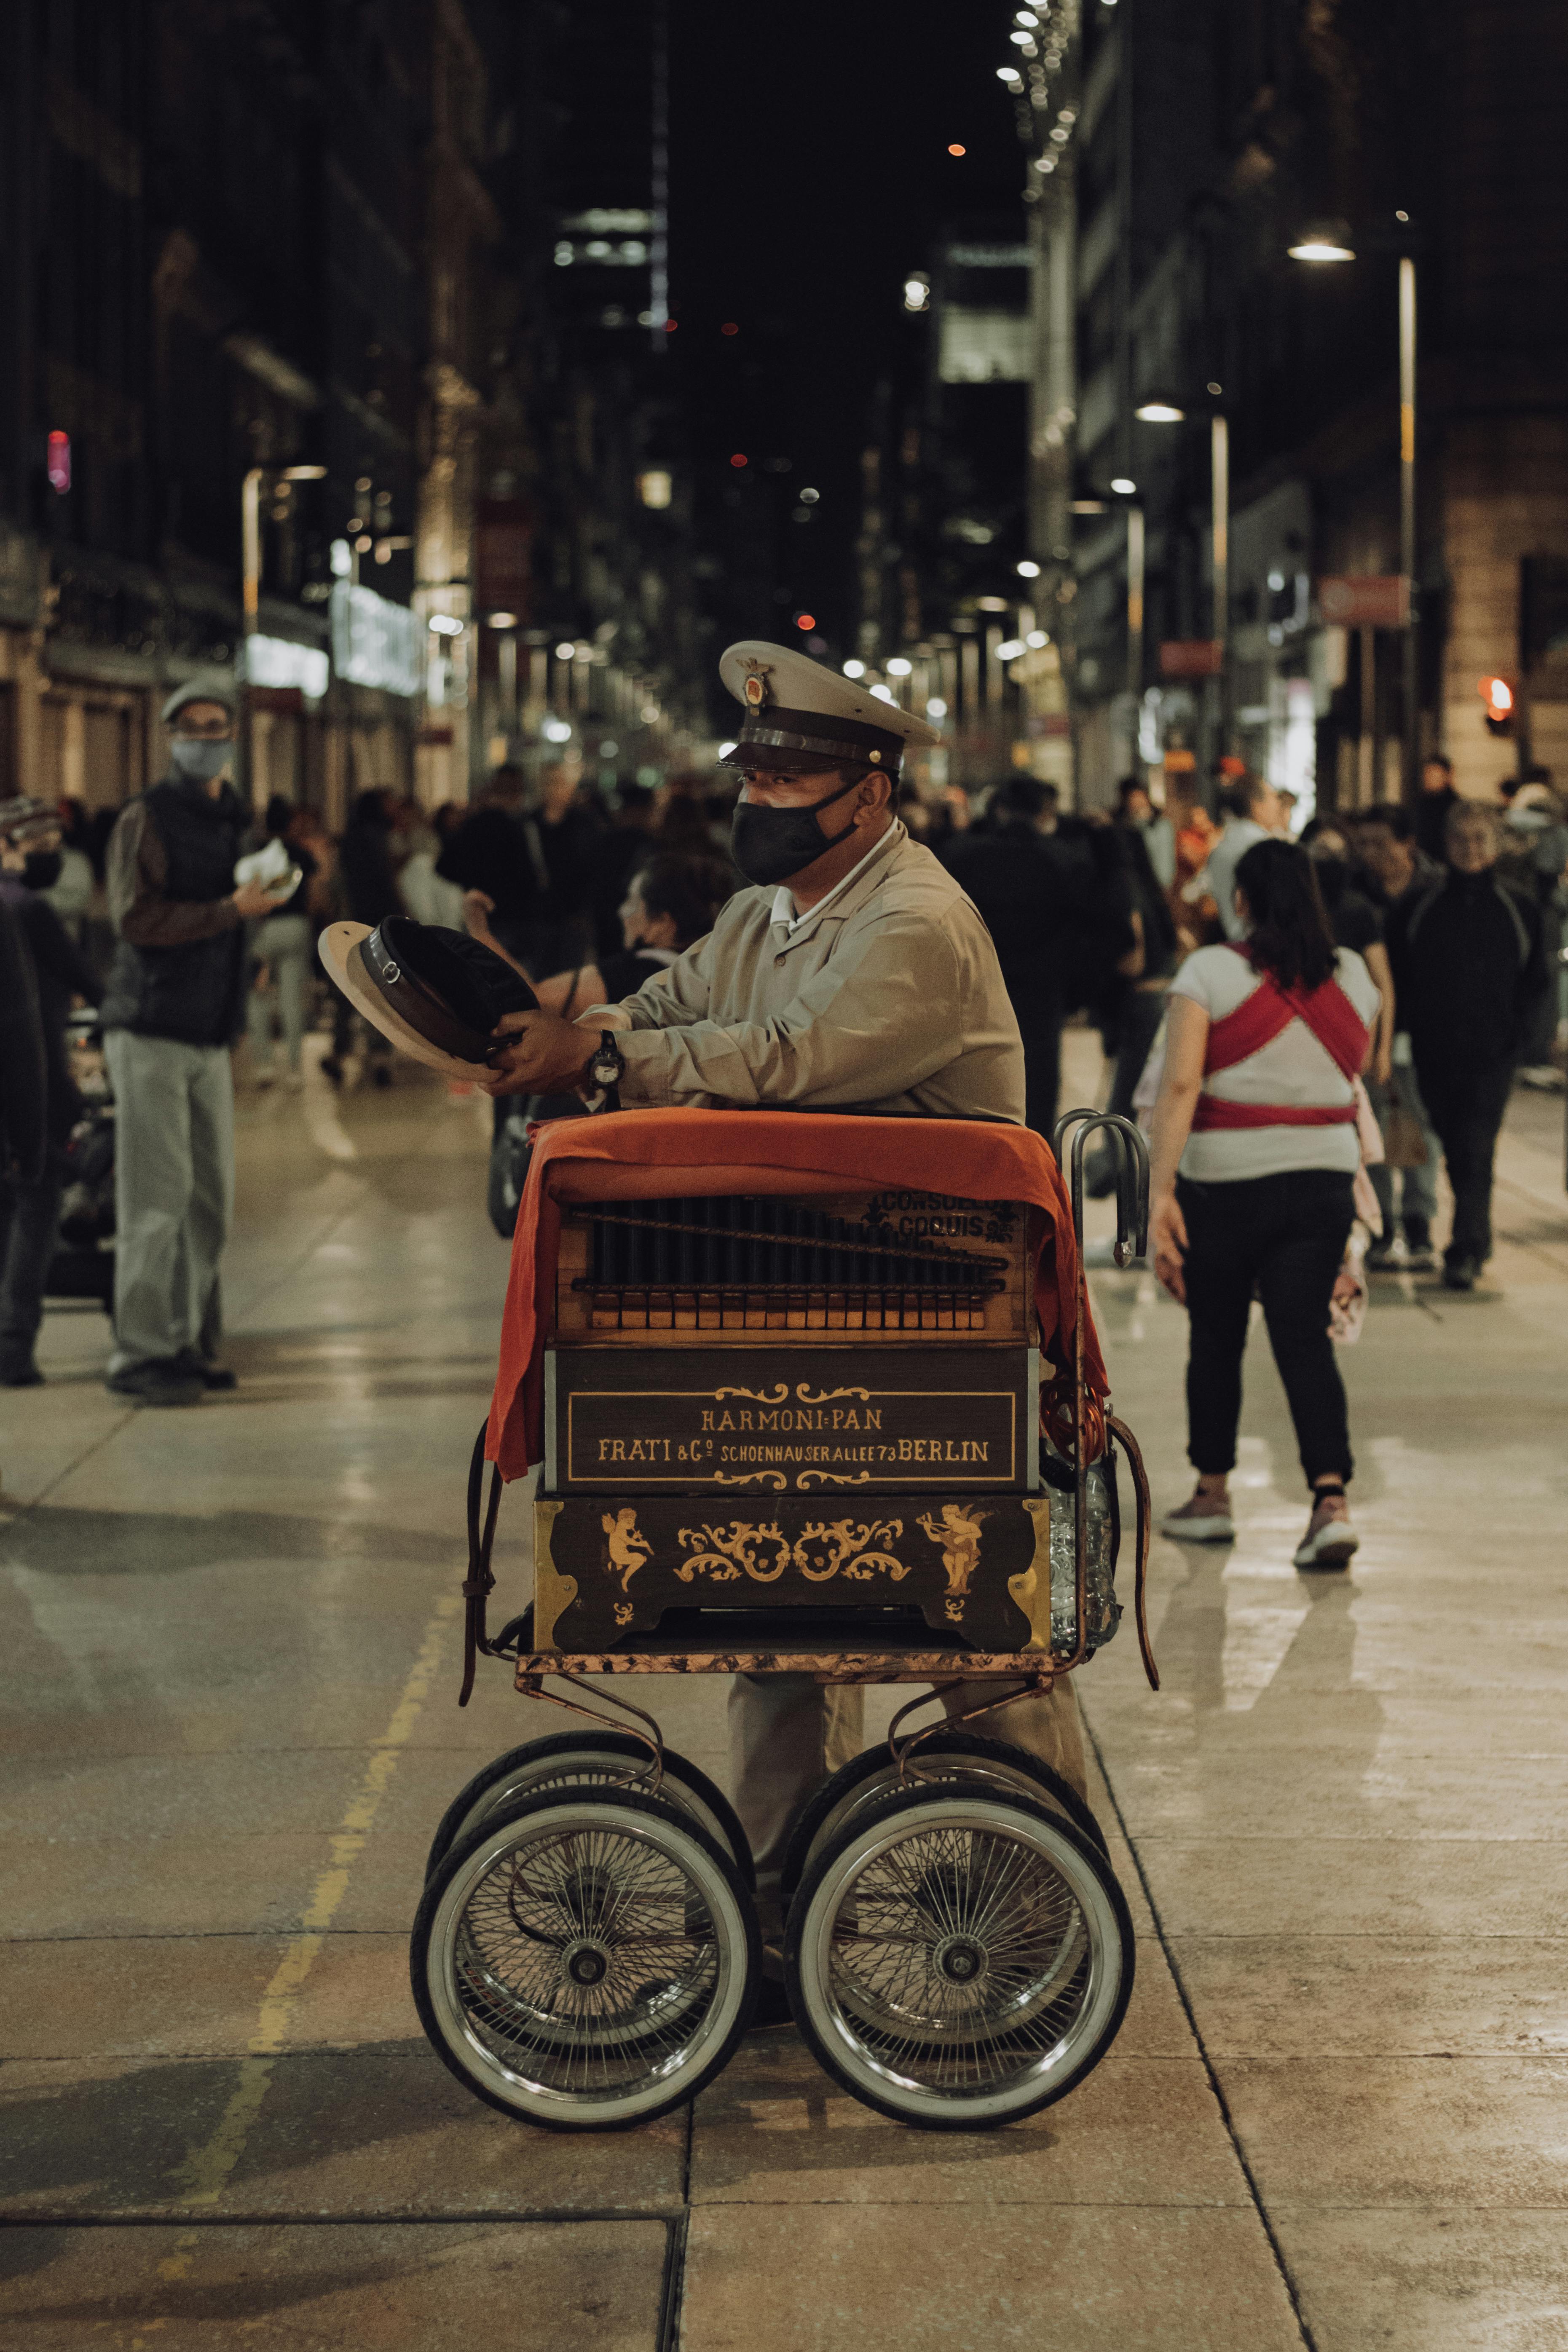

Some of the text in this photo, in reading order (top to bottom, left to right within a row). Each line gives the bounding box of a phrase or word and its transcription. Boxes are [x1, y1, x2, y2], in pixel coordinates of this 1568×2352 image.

[900, 1216, 983, 1237] COQUIS
[598, 1439, 671, 1461] FRATI
[877, 1445, 896, 1462] 73
[898, 1439, 989, 1462] BERLIN
